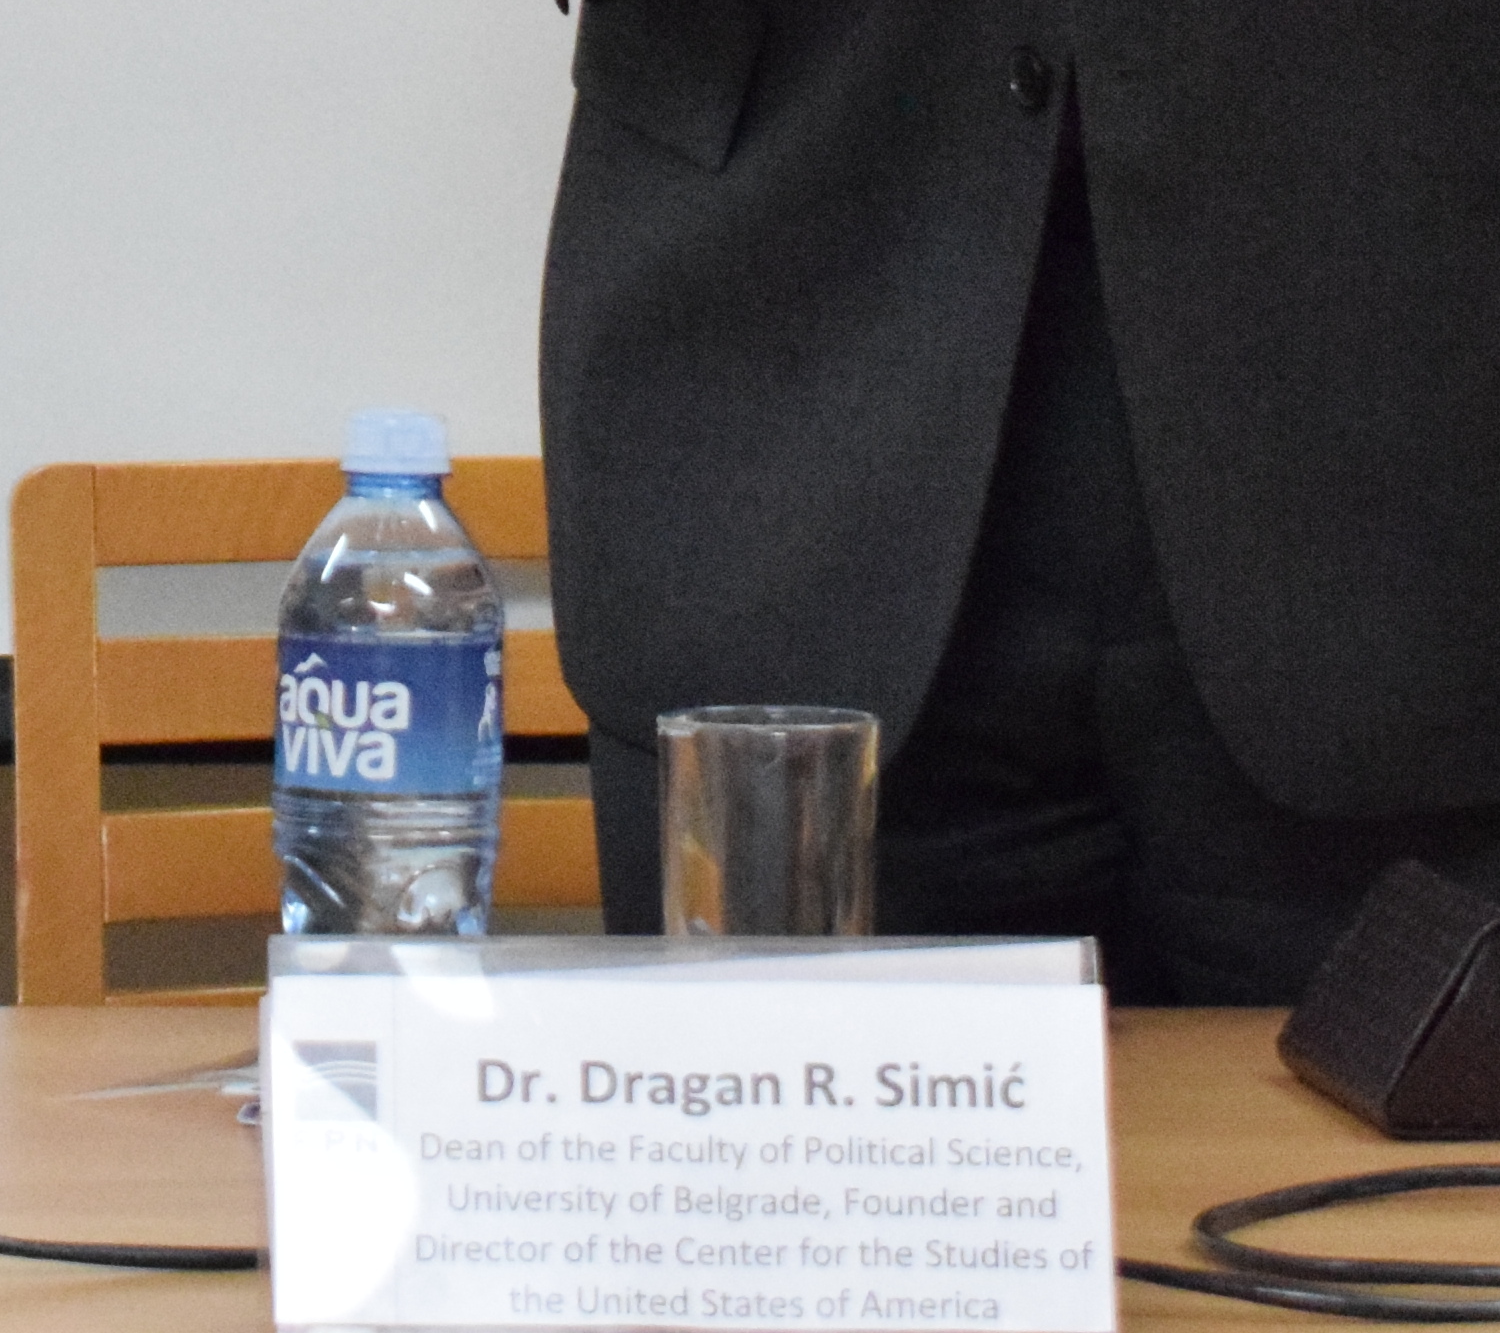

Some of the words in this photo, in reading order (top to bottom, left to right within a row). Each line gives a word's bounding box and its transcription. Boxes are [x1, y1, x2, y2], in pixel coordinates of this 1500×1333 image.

[279, 673, 410, 730] aqua
[282, 723, 396, 781] viva
[476, 1059, 559, 1106] Dr.
[580, 1059, 784, 1117] Dragan
[803, 1061, 856, 1109] R.
[874, 1061, 1027, 1111] Simić
[419, 1132, 506, 1165] Dean
[515, 1131, 553, 1164] of
[561, 1131, 618, 1164] the
[628, 1133, 750, 1172] Faculty
[758, 1133, 796, 1166] of
[803, 1134, 938, 1168] Political
[946, 1136, 1084, 1174] Science,
[446, 1183, 618, 1221] University
[627, 1183, 665, 1216] of
[674, 1184, 833, 1224] Belgrade,
[843, 1186, 987, 1219] Founder
[995, 1188, 1061, 1221] and
[414, 1233, 553, 1267] Director
[562, 1233, 600, 1267] of
[608, 1234, 667, 1268] the
[674, 1235, 790, 1269] Center
[798, 1236, 849, 1270] for
[857, 1237, 917, 1271] the
[925, 1238, 1051, 1273] Studies
[1058, 1240, 1096, 1274] of
[509, 1285, 566, 1316] the
[577, 1285, 692, 1319] United
[700, 1287, 806, 1320] States
[815, 1287, 852, 1320] of
[860, 1289, 1004, 1323] America
